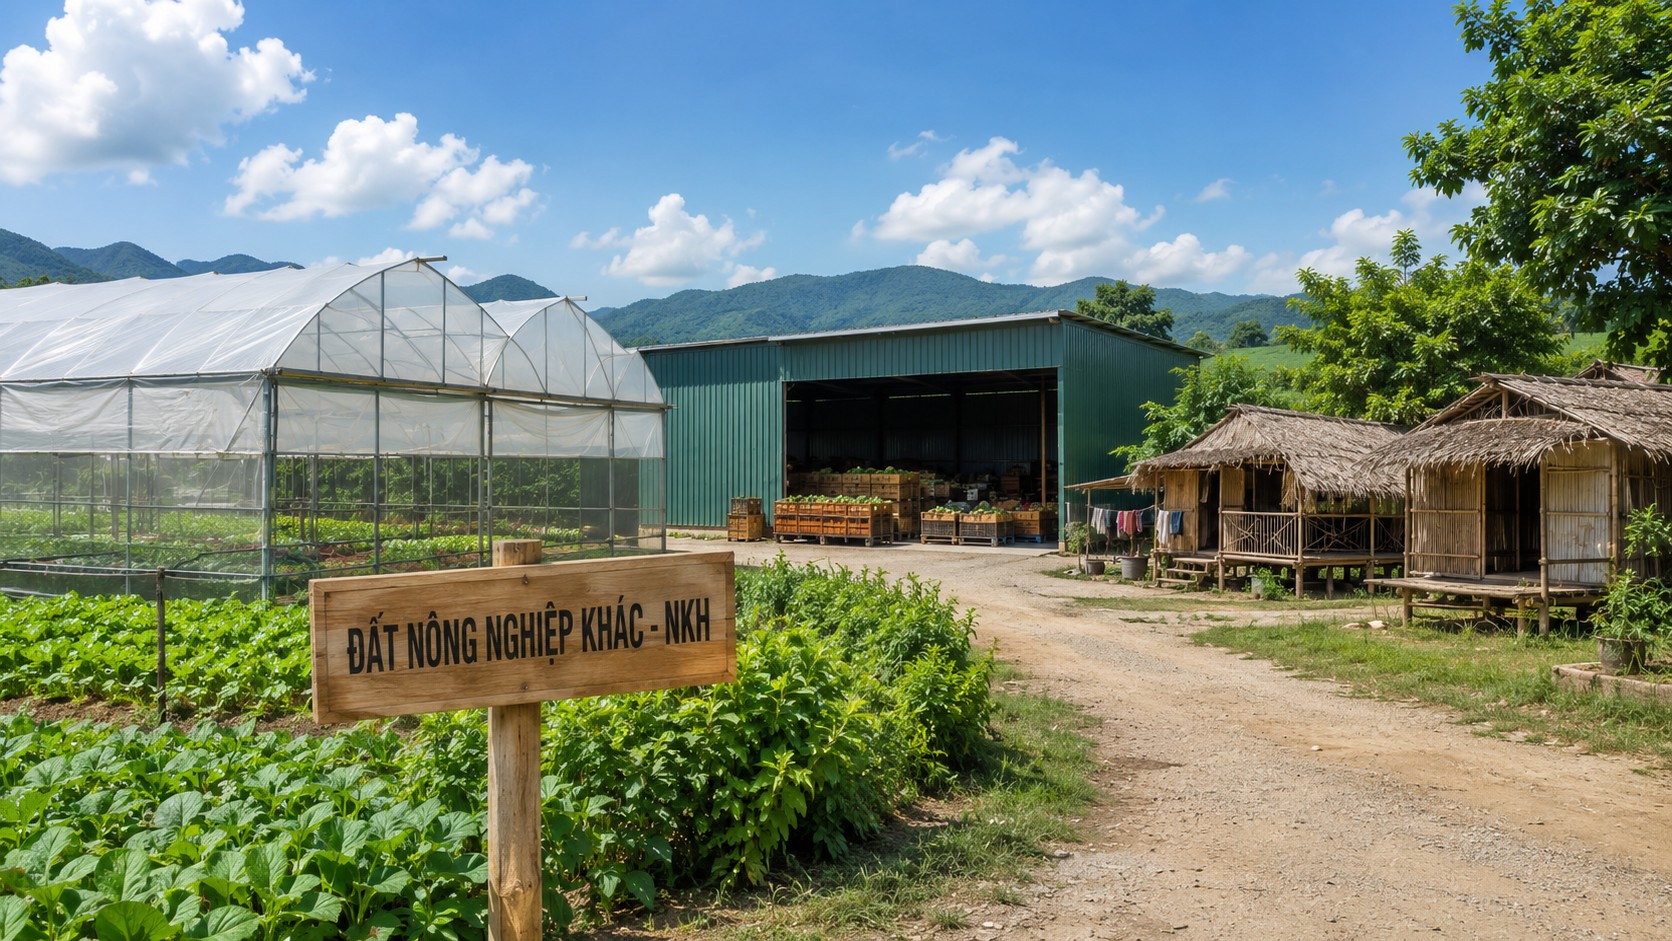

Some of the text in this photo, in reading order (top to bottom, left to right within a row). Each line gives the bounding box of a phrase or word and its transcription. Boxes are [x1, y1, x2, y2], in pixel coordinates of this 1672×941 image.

[347, 611, 399, 675] ĐẤT
[407, 610, 478, 670] NÔNG
[486, 600, 574, 666] NGHIỆP
[582, 594, 644, 653] KHÁC
[665, 597, 711, 645] NKH
